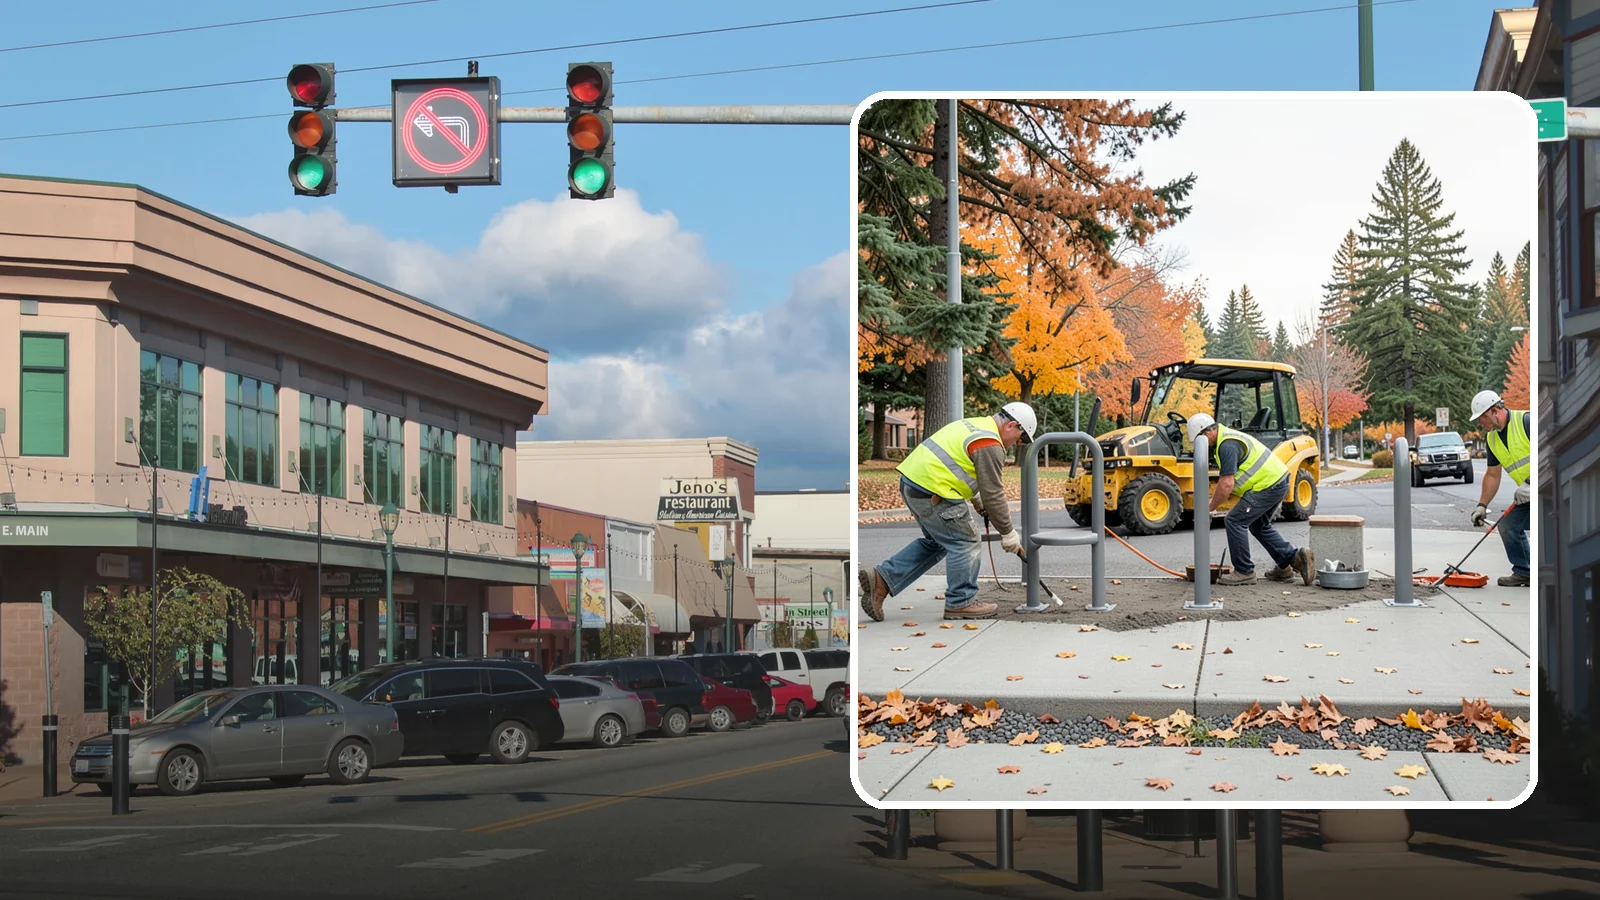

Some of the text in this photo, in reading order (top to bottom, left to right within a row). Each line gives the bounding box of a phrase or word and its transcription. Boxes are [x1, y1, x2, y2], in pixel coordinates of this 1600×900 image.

[669, 480, 728, 494] Jeno's
[665, 496, 731, 509] restaurant
[658, 510, 682, 520] Italian
[686, 510, 715, 519] American
[715, 510, 738, 519] Cuisine
[2, 525, 49, 536] E. MAIN
[797, 606, 829, 617] Street
